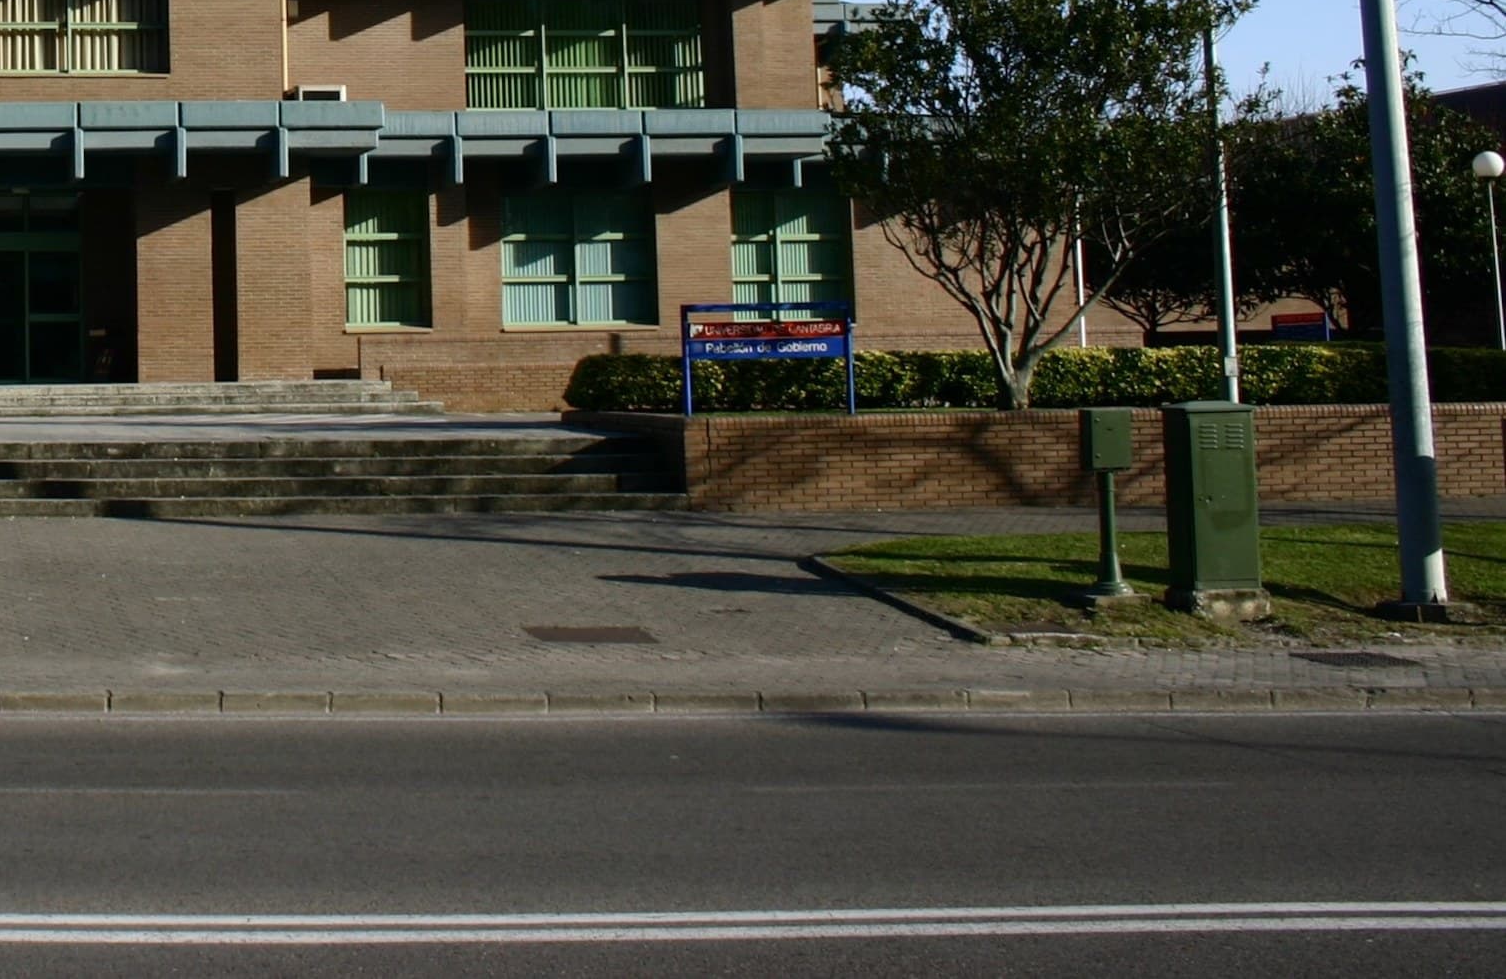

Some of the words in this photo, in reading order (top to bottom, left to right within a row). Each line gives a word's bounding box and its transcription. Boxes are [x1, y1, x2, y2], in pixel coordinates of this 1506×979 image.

[705, 341, 753, 354] Pabellón
[757, 340, 772, 353] de
[776, 340, 828, 353] Gobierno
